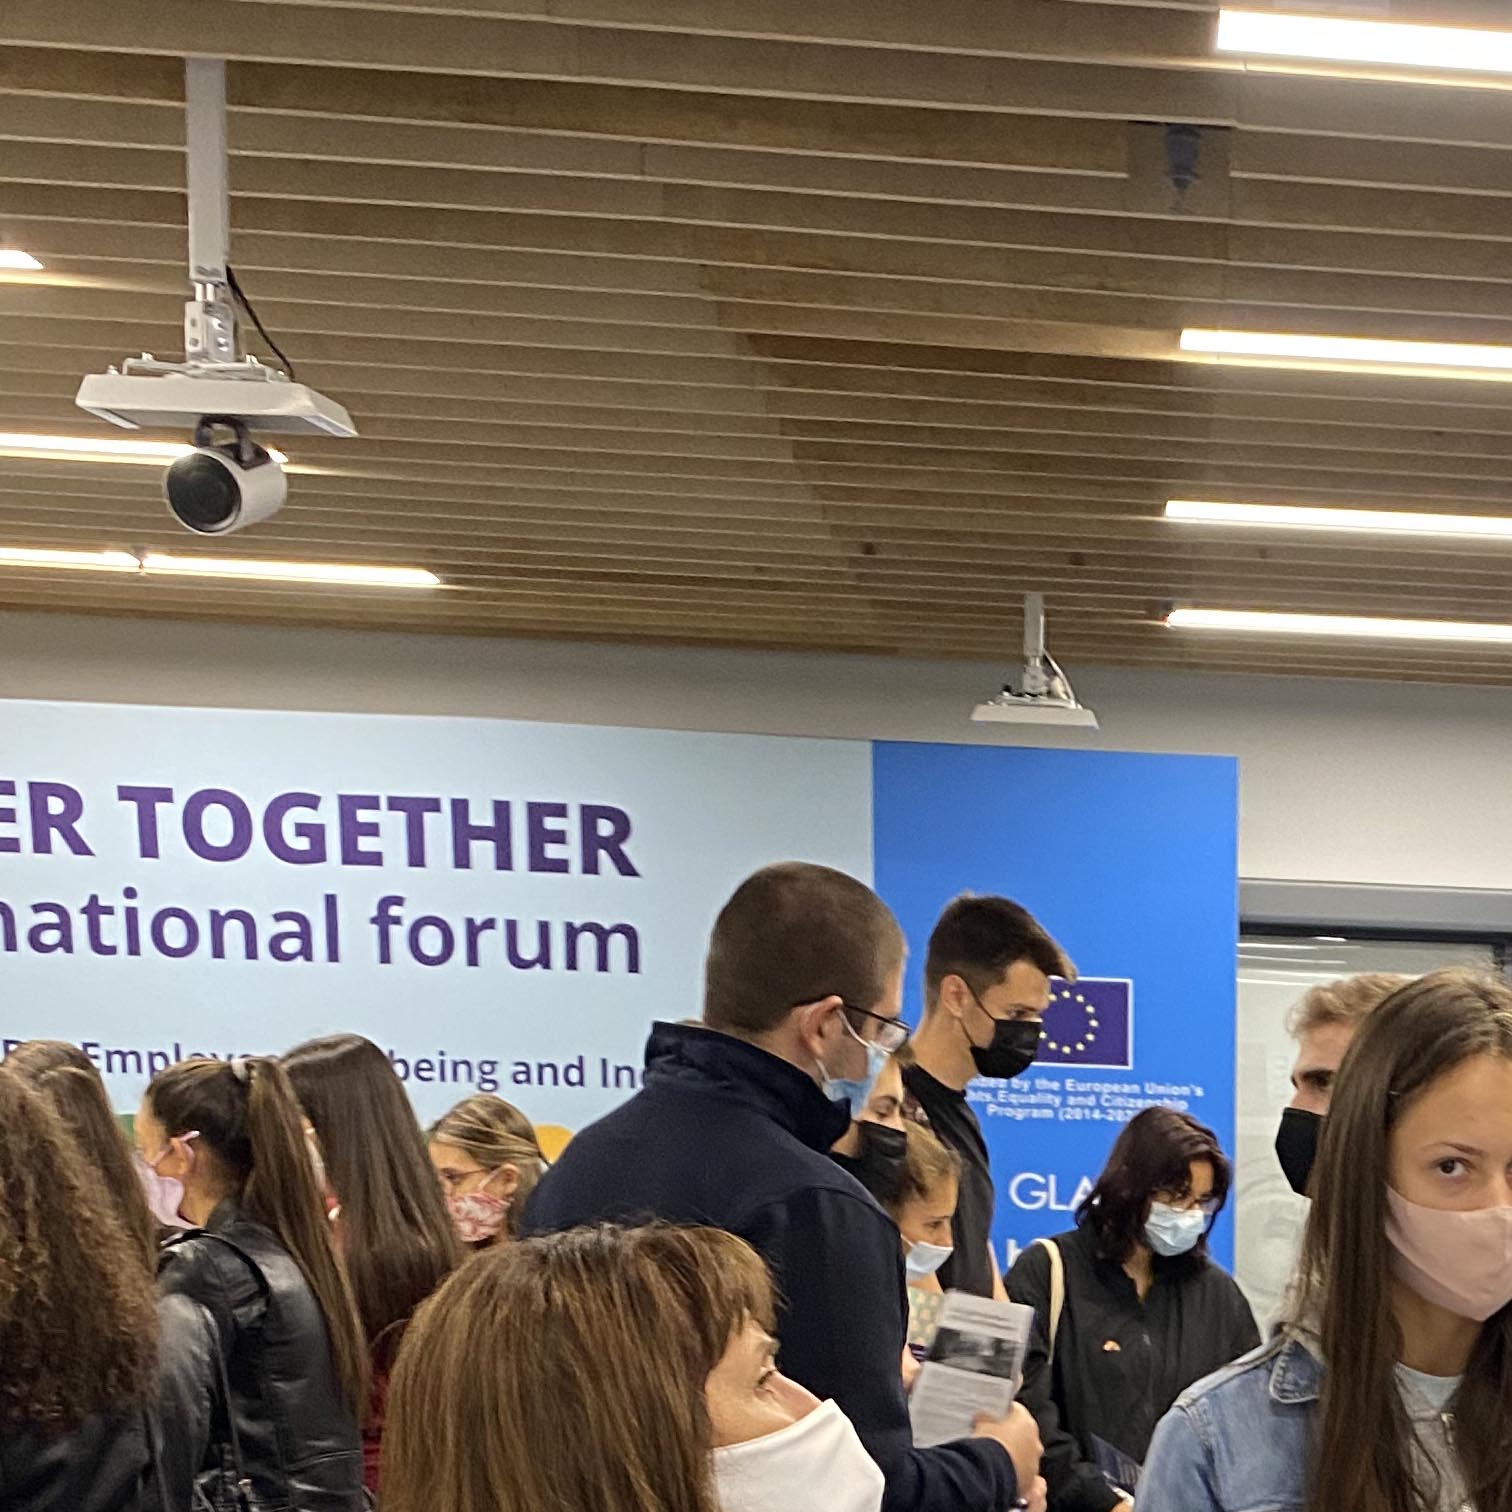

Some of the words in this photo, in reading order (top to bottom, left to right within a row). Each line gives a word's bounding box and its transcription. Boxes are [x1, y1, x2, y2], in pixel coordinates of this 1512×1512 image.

[117, 784, 641, 878] TOGETHER
[369, 894, 641, 974] forum
[512, 1055, 585, 1088] and
[600, 1057, 646, 1089] In
[997, 1090, 1062, 1108] Equality
[1067, 1094, 1097, 1107] and
[1012, 1078, 1031, 1092] by
[1034, 1078, 1061, 1090] the
[1064, 1078, 1141, 1096] European
[1144, 1081, 1205, 1096] Union's
[986, 1103, 1054, 1121] Program
